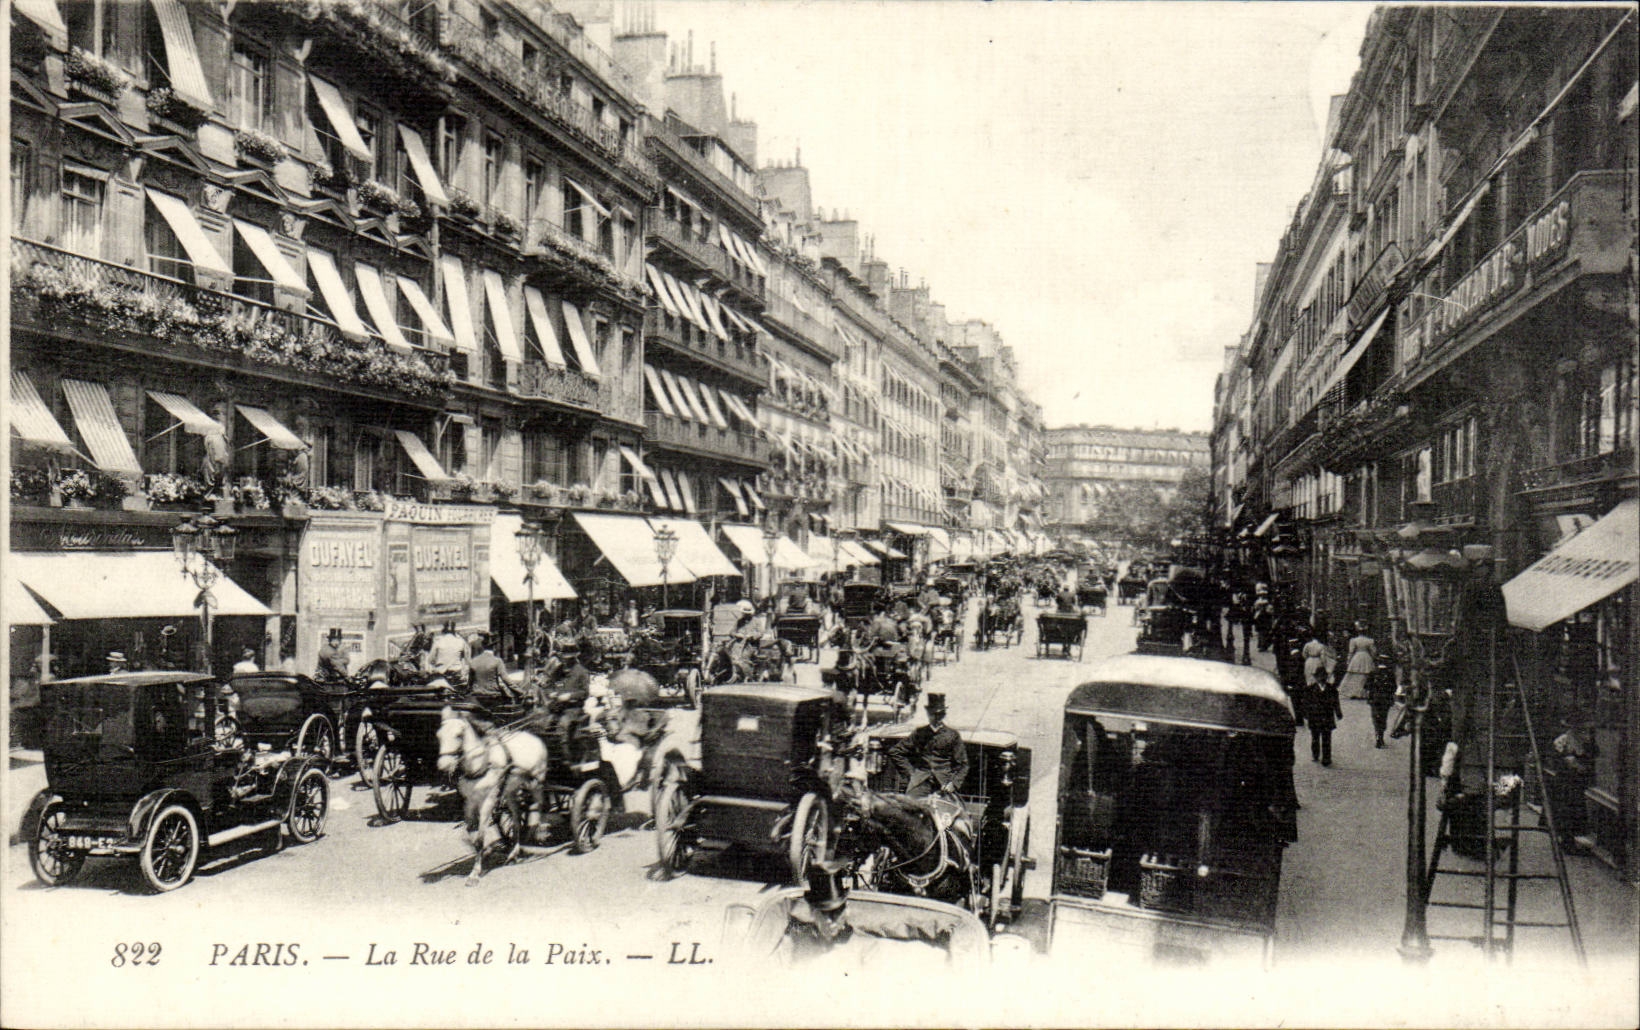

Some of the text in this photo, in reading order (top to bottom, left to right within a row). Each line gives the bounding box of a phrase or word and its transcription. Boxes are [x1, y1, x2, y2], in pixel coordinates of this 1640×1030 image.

[389, 503, 442, 521] PAQUIN
[309, 540, 375, 568] DUFAYEL
[414, 545, 469, 571] DUFAYEL
